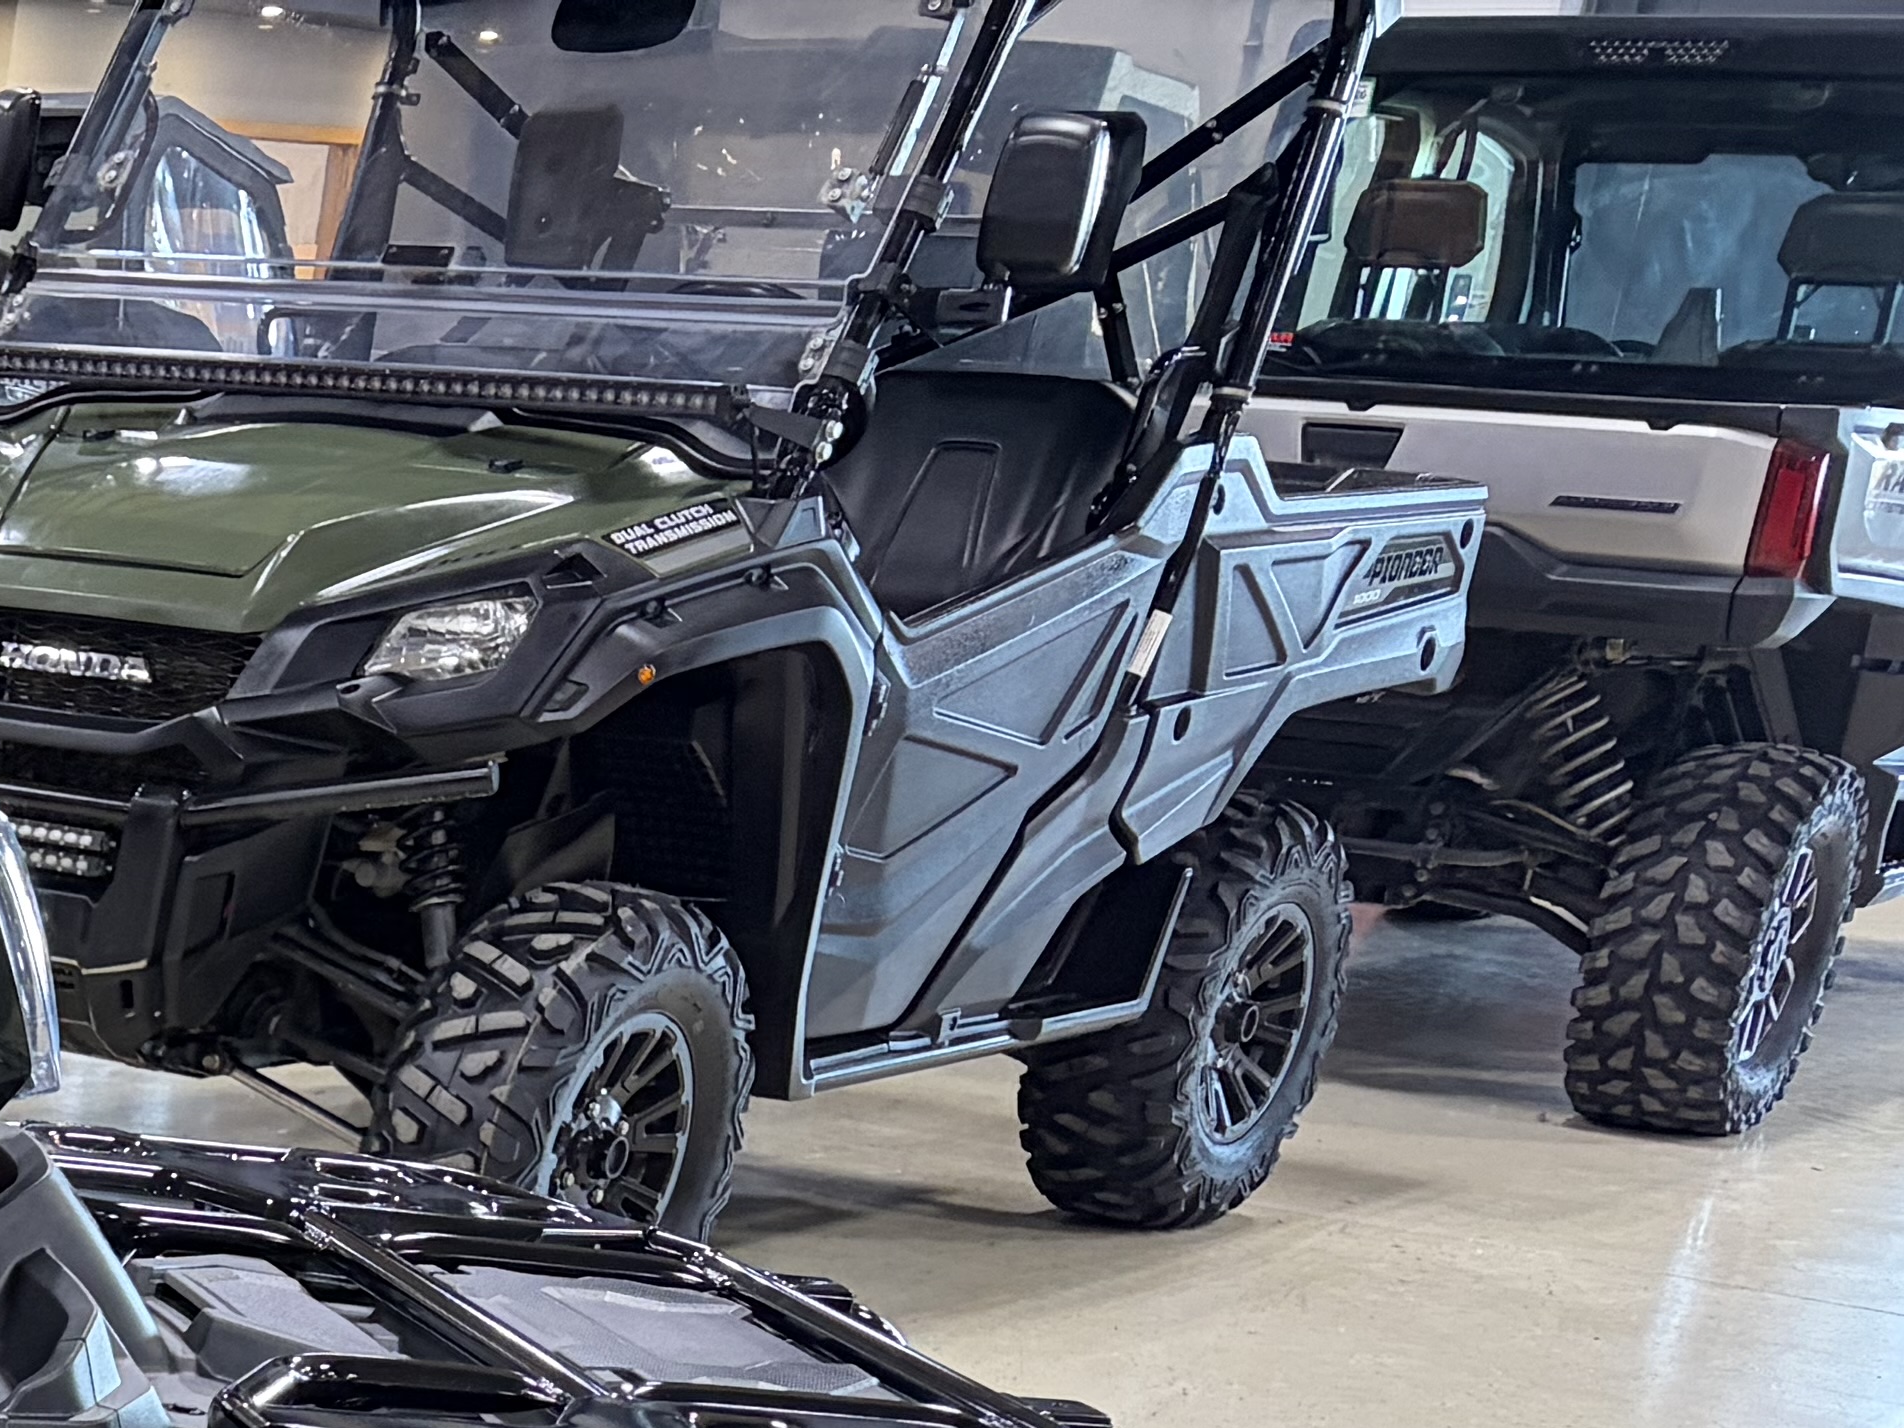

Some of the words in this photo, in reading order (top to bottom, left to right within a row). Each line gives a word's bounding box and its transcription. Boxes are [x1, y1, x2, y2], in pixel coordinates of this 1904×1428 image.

[610, 523, 655, 545] DUAL
[653, 503, 714, 530] CLUTCH
[624, 509, 738, 555] TRANSMISSION
[1367, 546, 1444, 586] PIONEER
[1353, 588, 1381, 605] 1000
